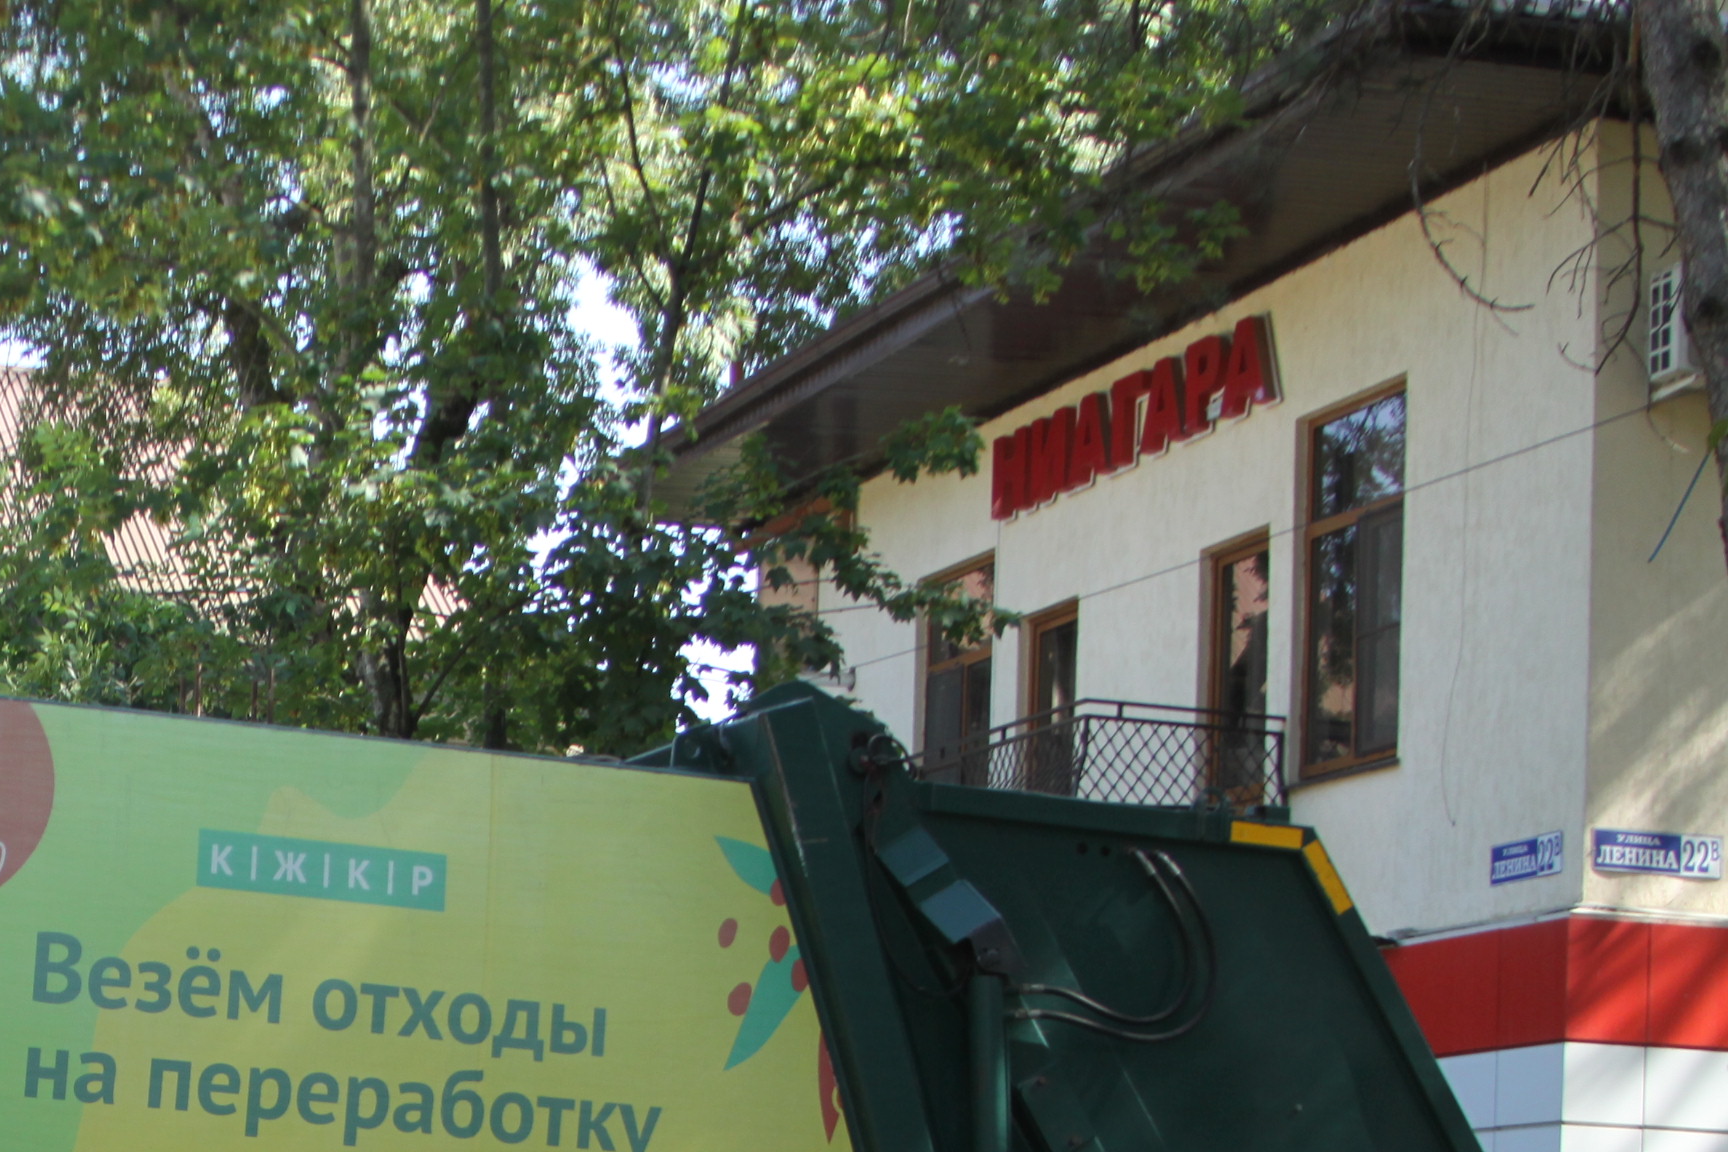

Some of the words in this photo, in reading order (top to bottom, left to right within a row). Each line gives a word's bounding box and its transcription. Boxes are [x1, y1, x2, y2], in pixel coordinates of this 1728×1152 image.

[991, 313, 1280, 521] НИАГАРА
[1492, 854, 1538, 880] ЛЕНИНА
[1597, 844, 1679, 869] ЛЕНИНА
[1616, 833, 1660, 846] УЛИЦА
[1682, 839, 1720, 873] 22В
[31, 930, 284, 1025] Везём
[311, 977, 608, 1063] отходы
[23, 1045, 118, 1106] на
